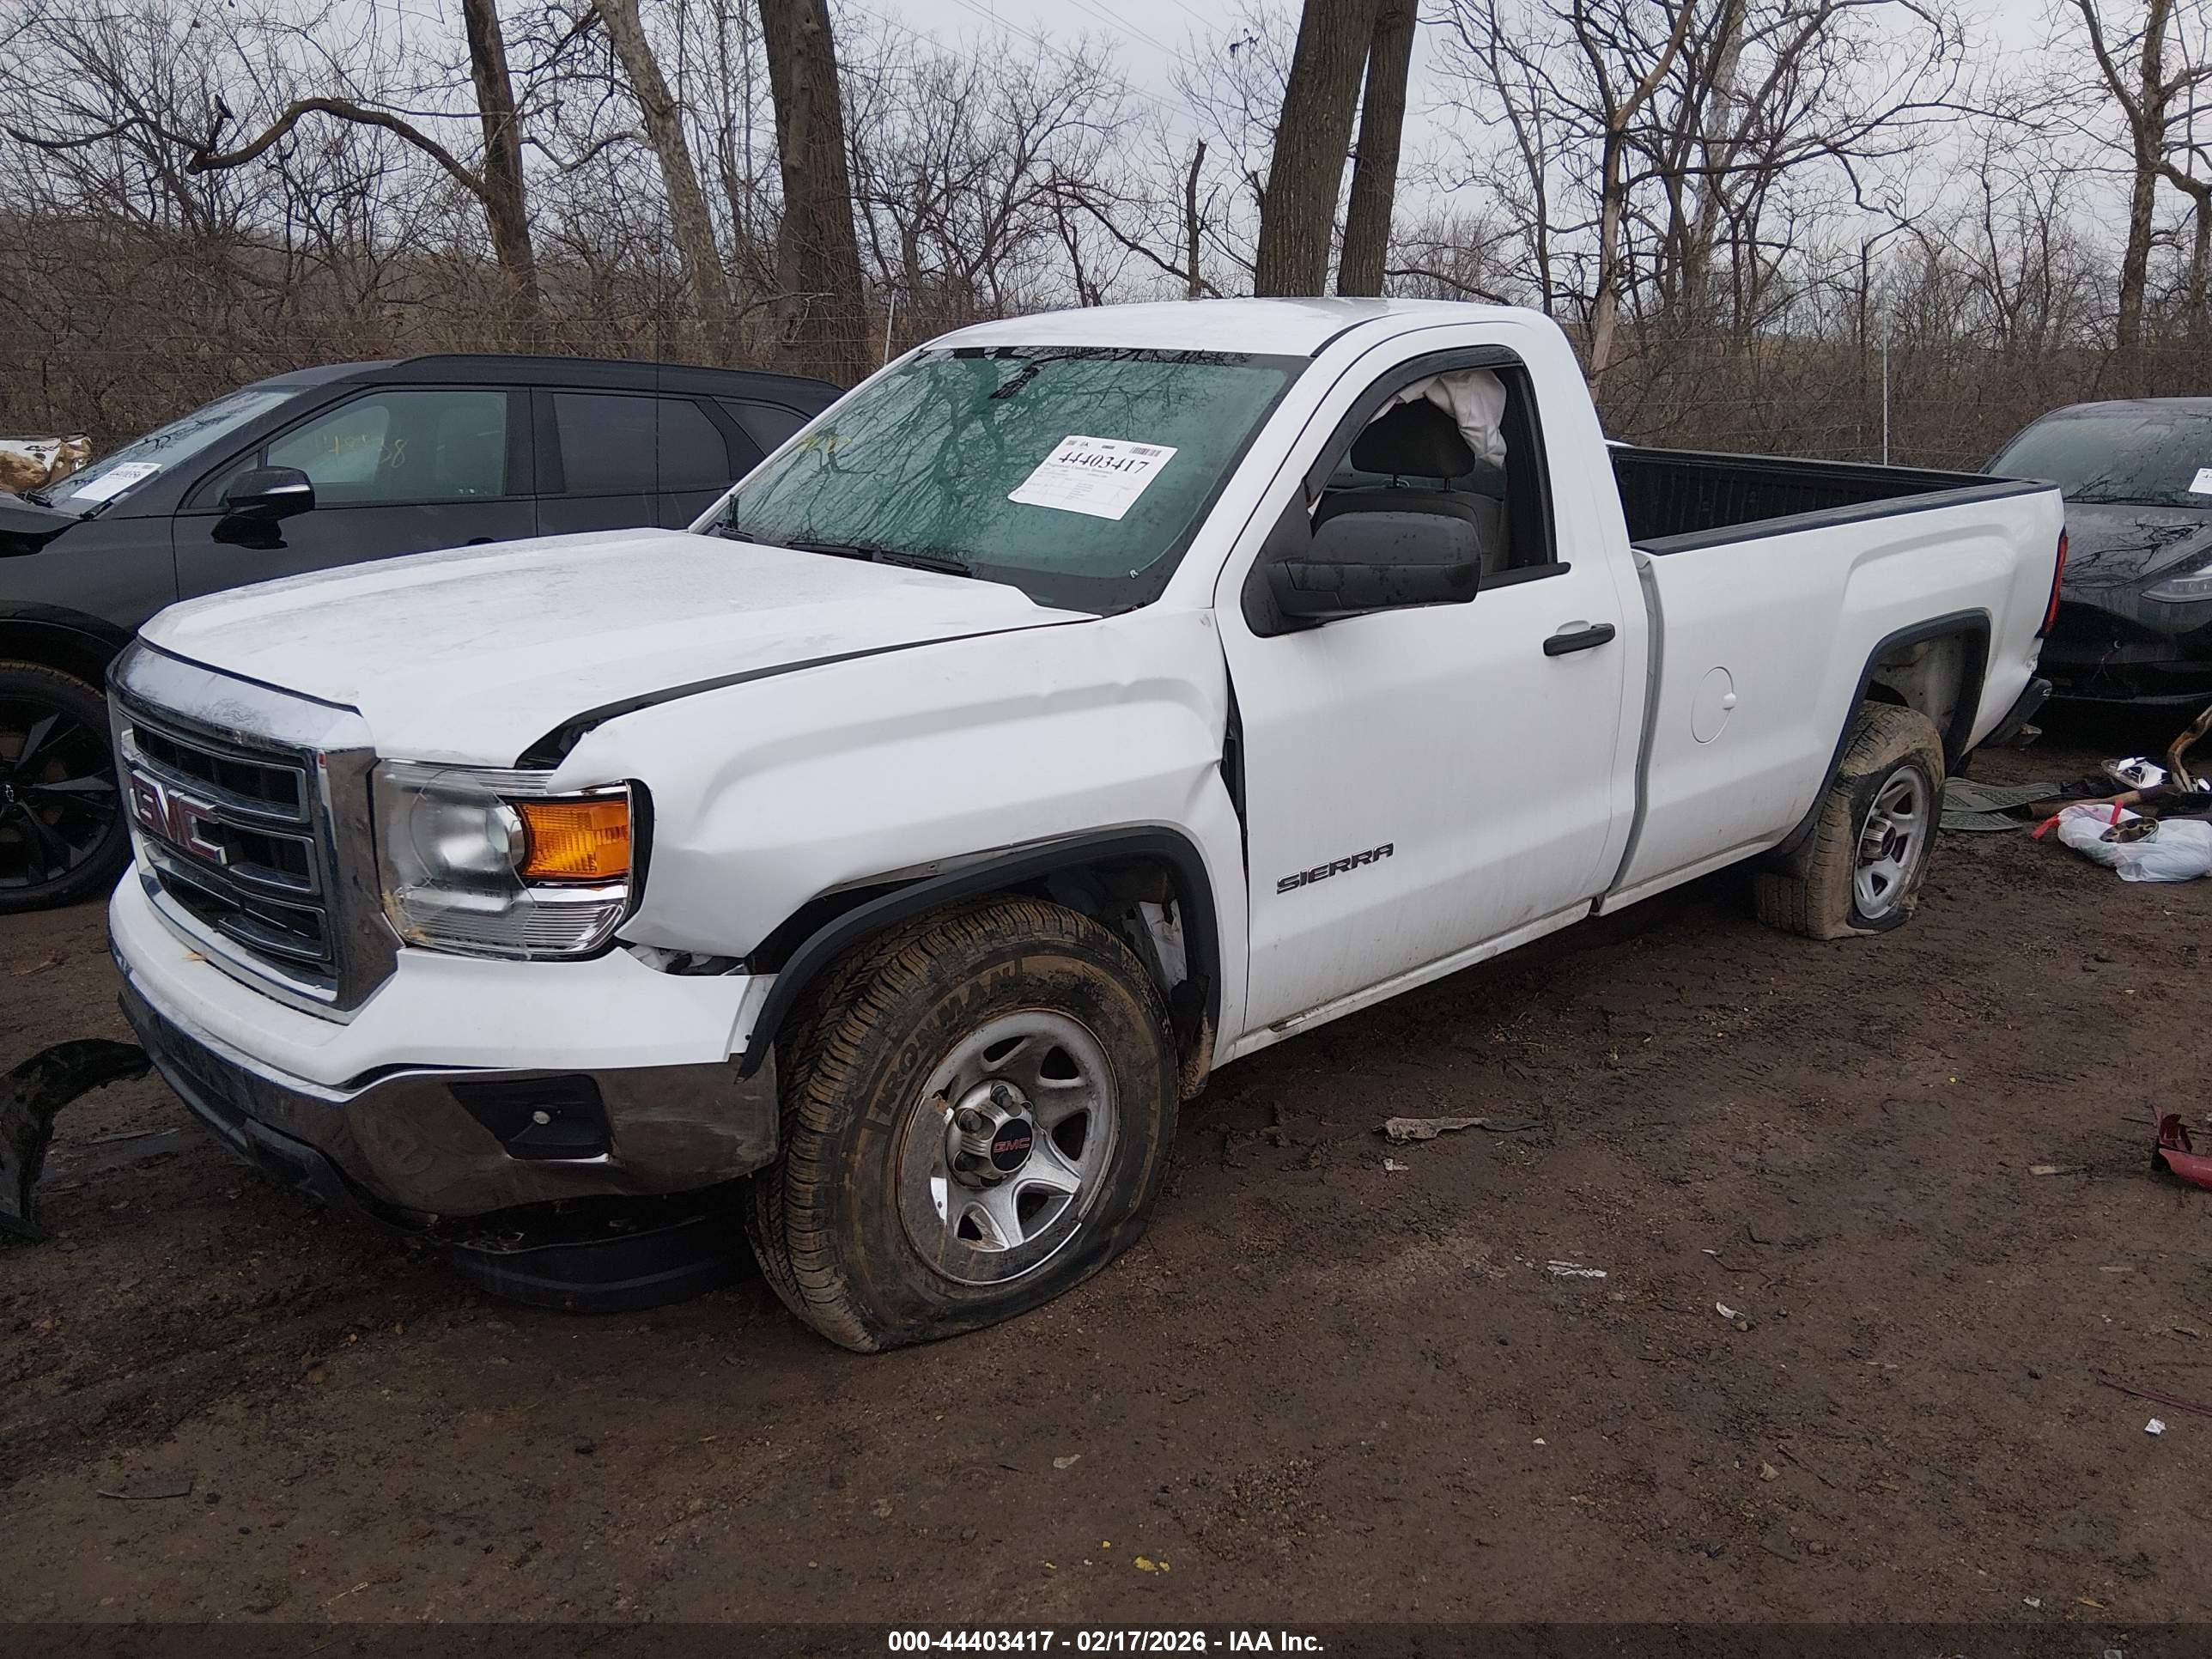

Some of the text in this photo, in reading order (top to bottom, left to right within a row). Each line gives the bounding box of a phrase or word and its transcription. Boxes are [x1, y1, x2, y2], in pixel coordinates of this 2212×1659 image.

[1058, 451, 1150, 474] 44403417
[129, 769, 228, 866] GMC
[1276, 842, 1395, 895] SIERRA
[993, 1137, 1030, 1153] GMC
